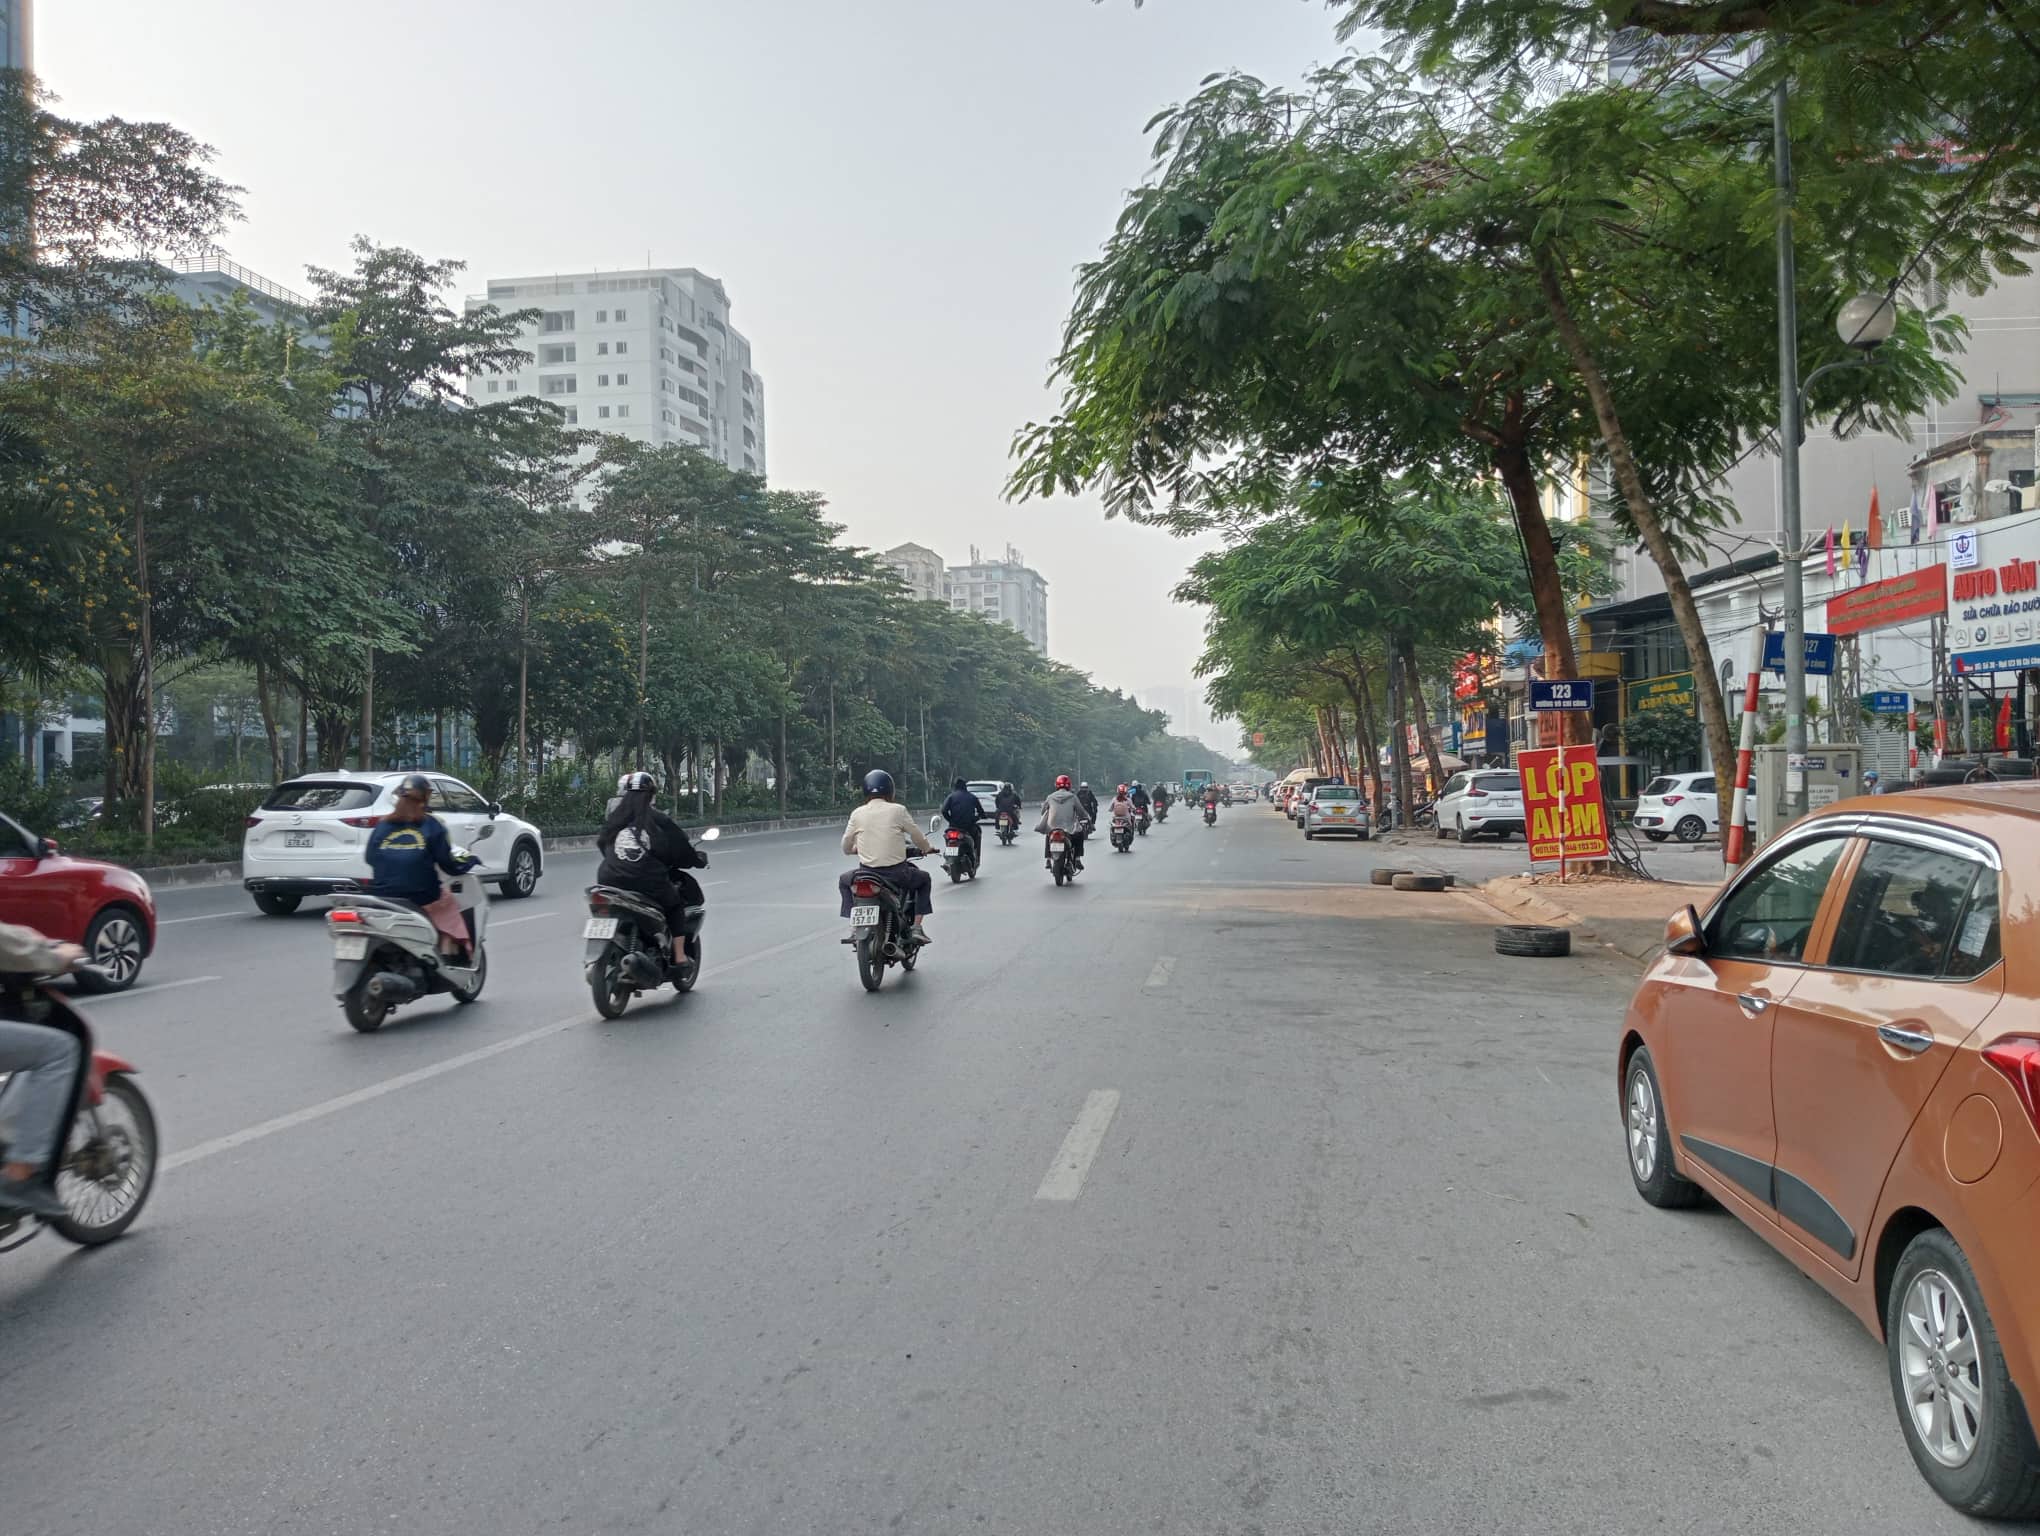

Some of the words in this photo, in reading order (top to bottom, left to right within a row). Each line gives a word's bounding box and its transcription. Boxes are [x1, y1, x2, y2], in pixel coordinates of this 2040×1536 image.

[1953, 568, 1997, 602] AUTO
[1963, 606, 1977, 620] SỬA
[1980, 603, 2001, 618] CHỮA
[2003, 600, 2020, 615] BẢO
[1550, 684, 1572, 699] 123
[1525, 750, 1596, 801] LỐP
[1532, 803, 1601, 841] ABM
